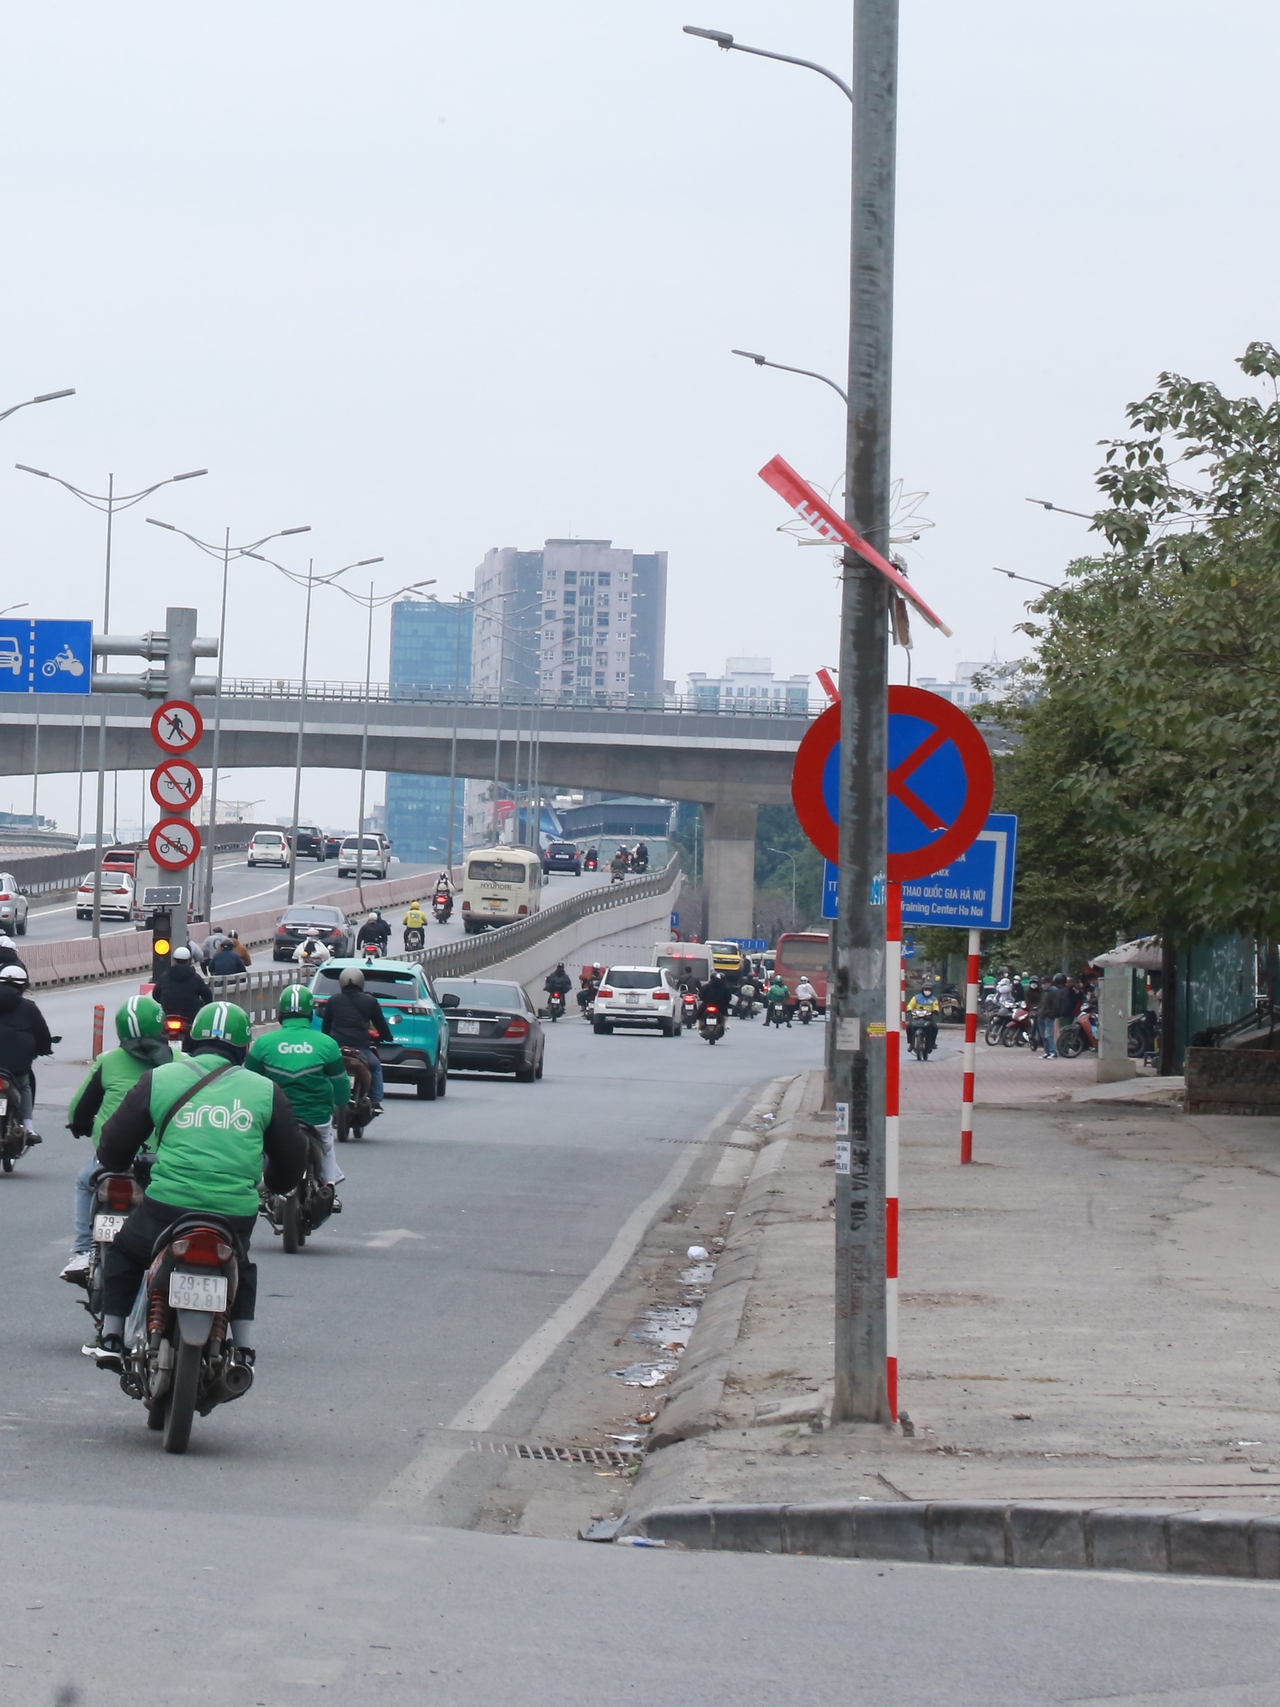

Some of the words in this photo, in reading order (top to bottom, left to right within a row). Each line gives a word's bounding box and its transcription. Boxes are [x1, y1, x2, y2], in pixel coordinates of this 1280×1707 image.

[923, 884, 944, 899] QUỐC
[945, 889, 958, 900] GIA
[960, 887, 971, 901] HÀ
[973, 890, 986, 902] NỘI
[931, 902, 957, 915] Center
[959, 905, 969, 915] Ha
[970, 906, 984, 917] Noi
[277, 1041, 313, 1054] Grab
[174, 1099, 254, 1132] Grab
[179, 1275, 219, 1293] 29-E1
[173, 1291, 222, 1309] 592.81
